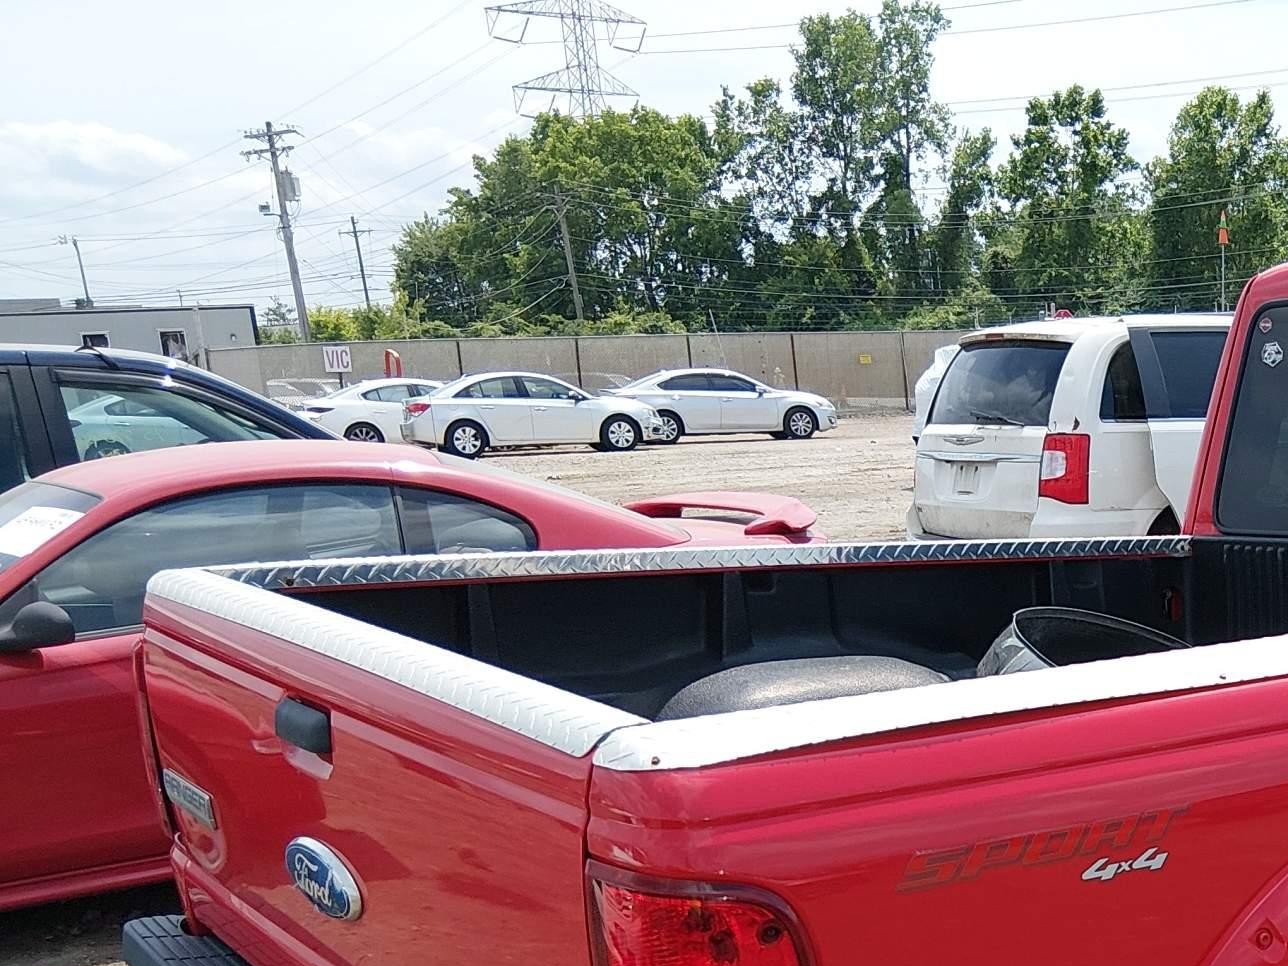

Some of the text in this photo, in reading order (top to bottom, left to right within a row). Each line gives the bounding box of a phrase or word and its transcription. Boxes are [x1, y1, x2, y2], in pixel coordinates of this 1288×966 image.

[325, 350, 350, 369] VIC
[896, 801, 1191, 893] SPORT
[1081, 847, 1169, 881] 4x4
[293, 853, 333, 907] Ford
